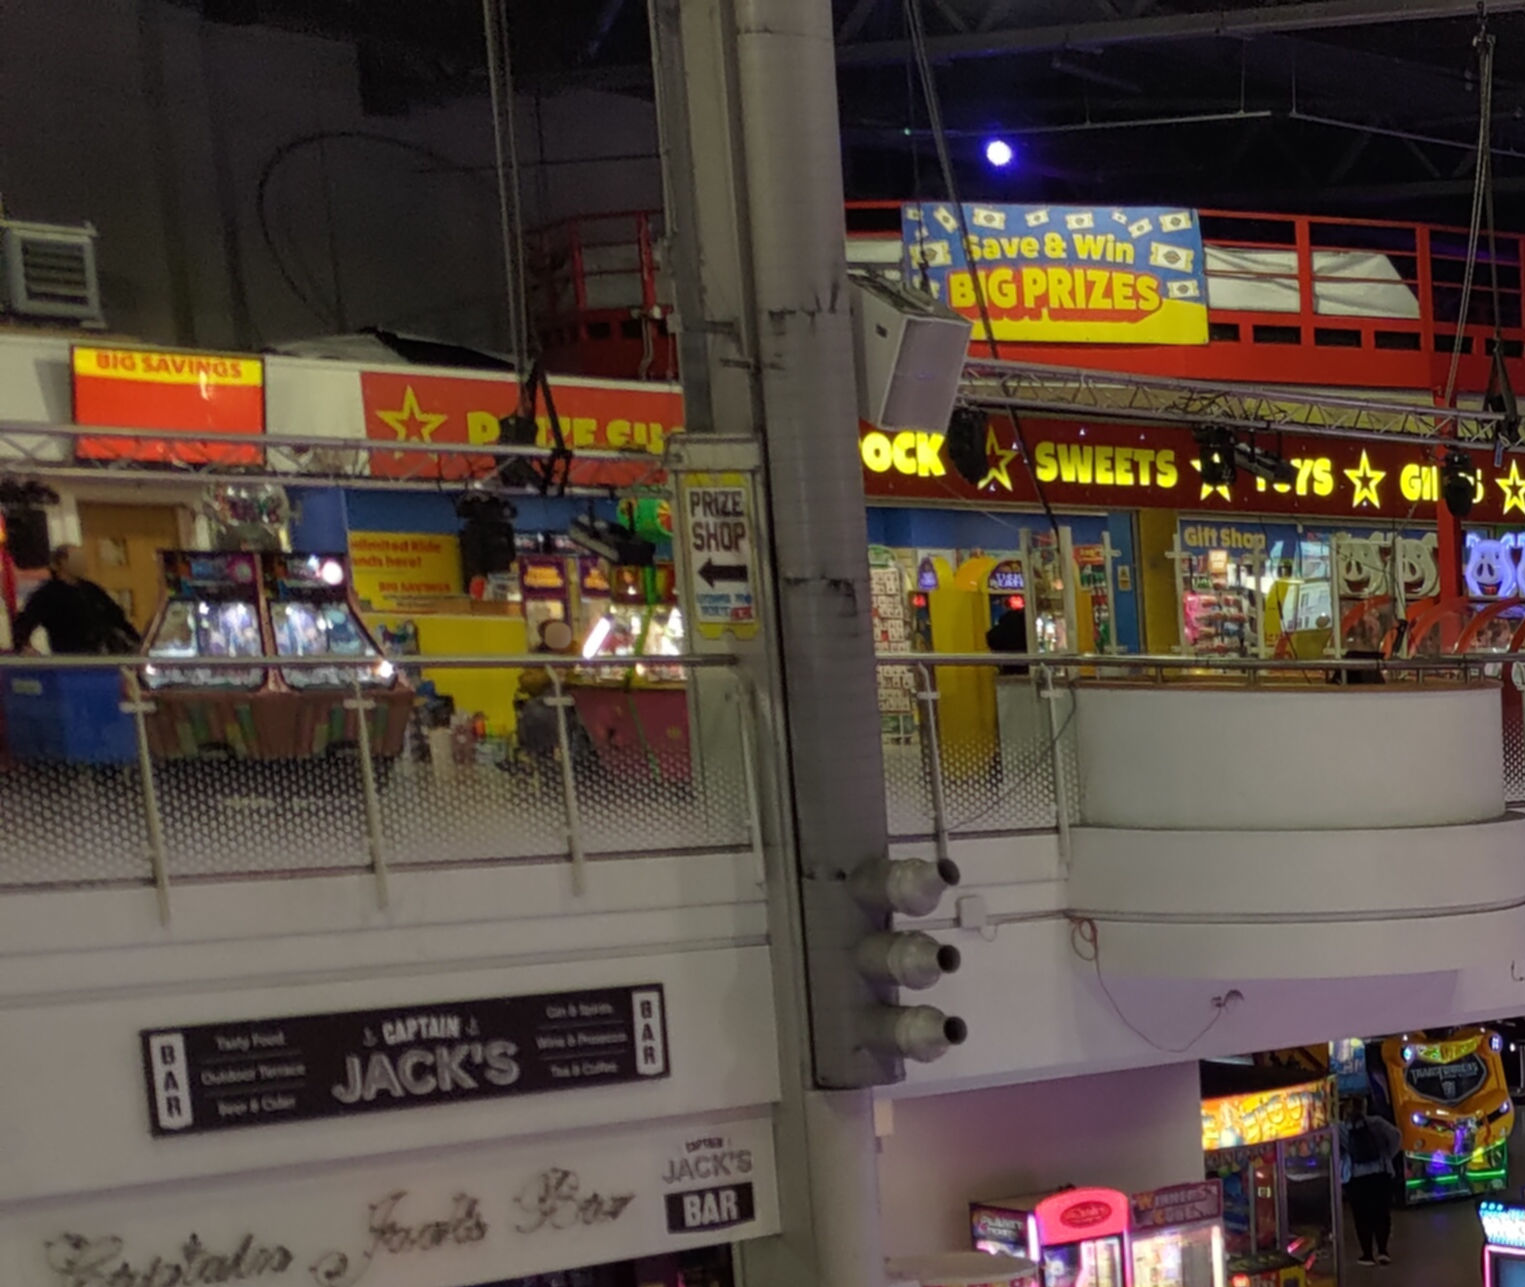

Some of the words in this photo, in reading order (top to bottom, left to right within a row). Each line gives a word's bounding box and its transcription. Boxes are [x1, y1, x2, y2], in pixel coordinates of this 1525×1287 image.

[965, 234, 1038, 260] Save
[1045, 234, 1067, 258] &
[1073, 233, 1135, 264] Win
[949, 270, 1016, 309] BIG
[1022, 268, 1160, 312] PRIZES
[96, 353, 135, 372] BIG
[141, 354, 242, 379] SAVINGS
[467, 411, 597, 450] PIZE
[862, 431, 946, 476] OCK
[1035, 442, 1178, 488] SWEETS
[689, 490, 744, 517] PRIZE
[692, 521, 746, 552] SHOP
[1184, 525, 1217, 548] Gift
[1220, 529, 1266, 552] Shop
[382, 1015, 460, 1045] CAPTAIN
[332, 1040, 521, 1104] JACK'S
[662, 1150, 752, 1184] JACK'S
[683, 1189, 738, 1228] BAR
